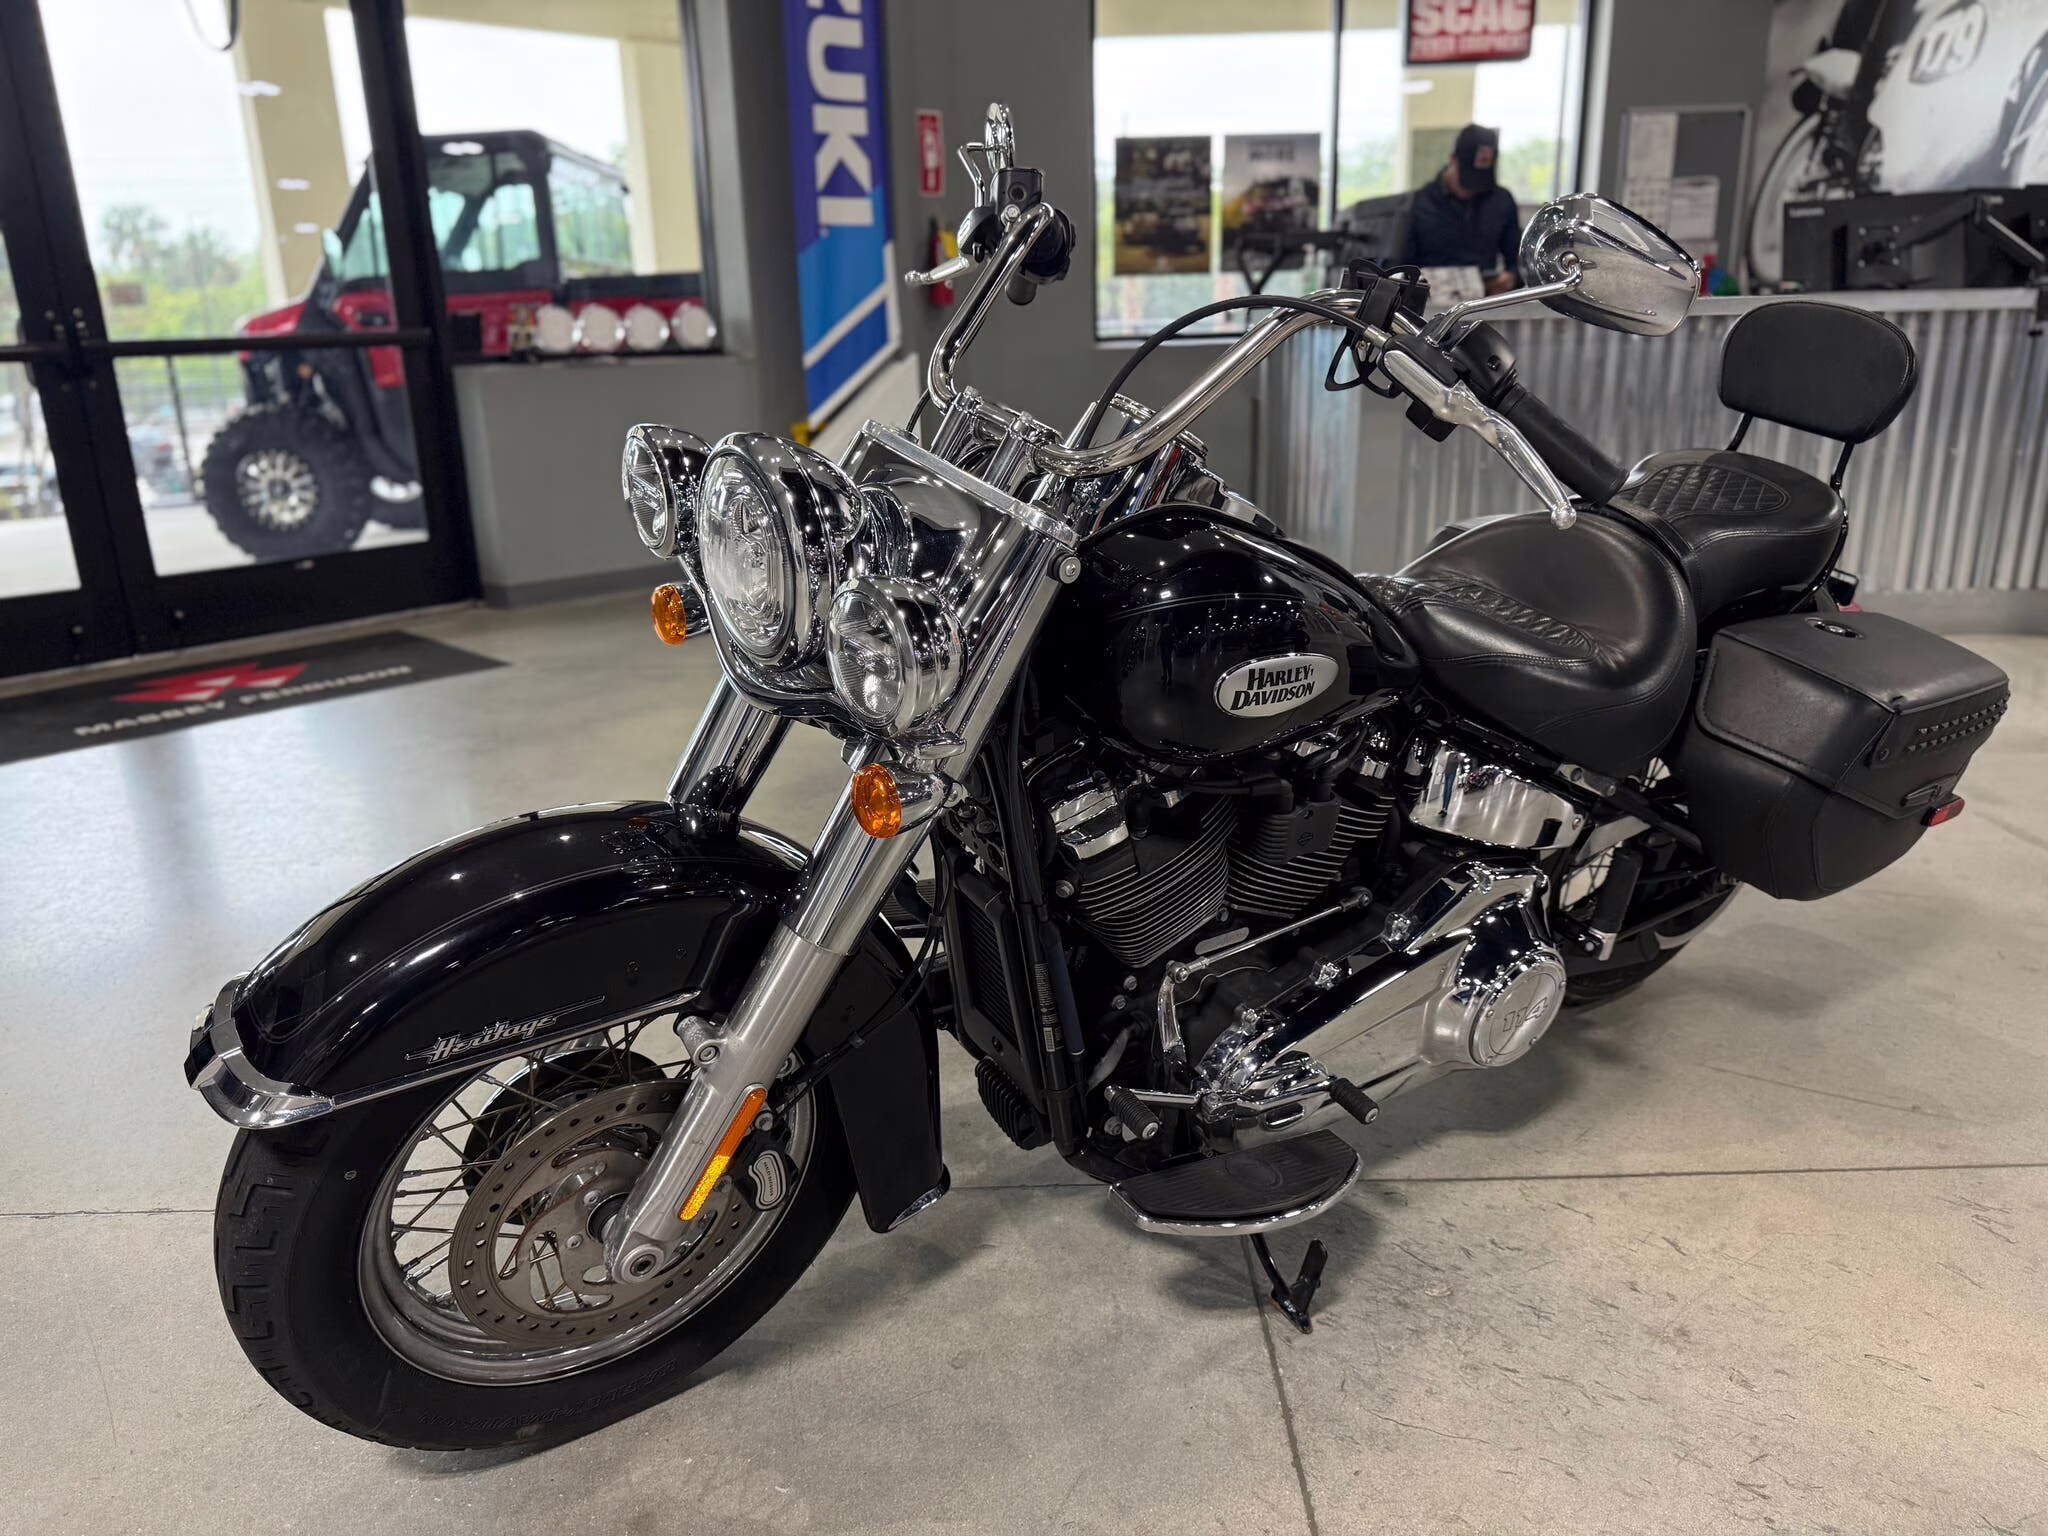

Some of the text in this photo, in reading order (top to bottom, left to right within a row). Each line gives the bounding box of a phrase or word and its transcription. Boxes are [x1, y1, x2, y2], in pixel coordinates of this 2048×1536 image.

[805, 0, 874, 227] UKI
[1230, 681, 1315, 710] DAVIDSON
[1502, 996, 1549, 1033] 114
[420, 1014, 565, 1064] Heritage
